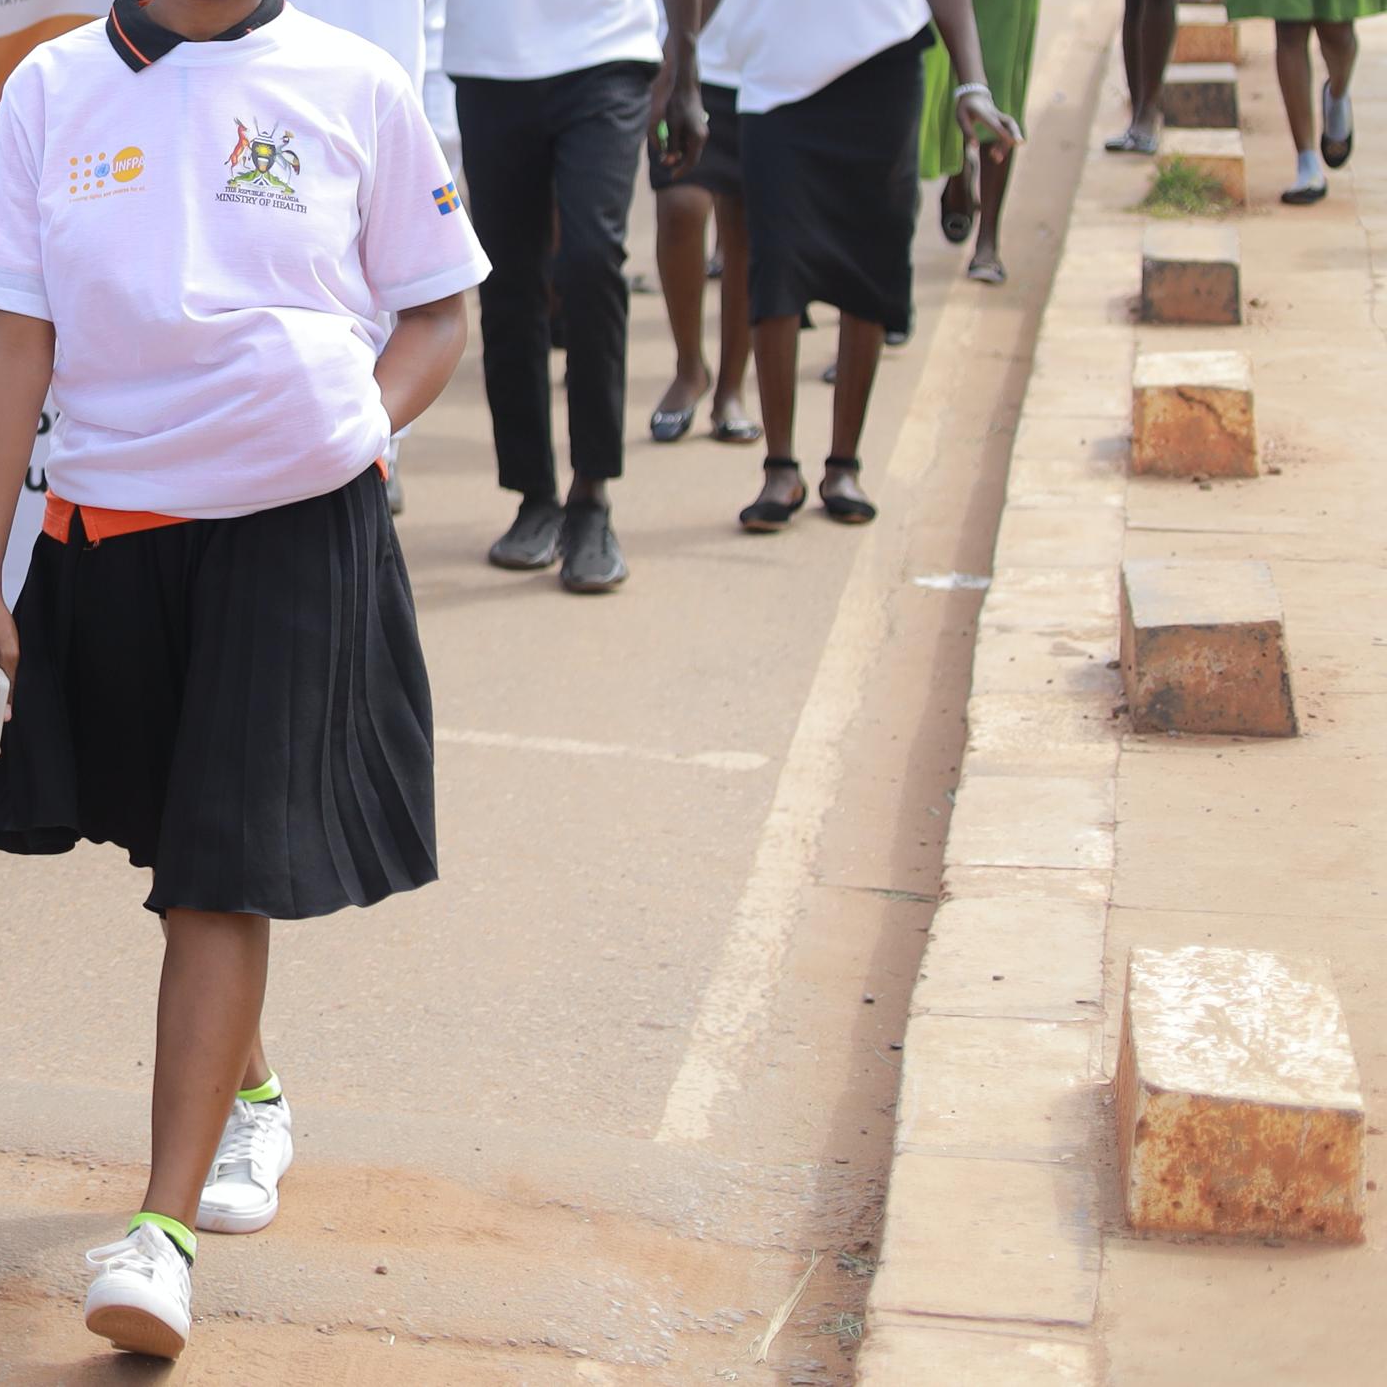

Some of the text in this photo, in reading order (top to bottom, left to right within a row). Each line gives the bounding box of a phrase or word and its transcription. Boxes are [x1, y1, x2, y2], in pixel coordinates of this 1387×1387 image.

[215, 192, 308, 214] MINISTRY OF HEALTH
